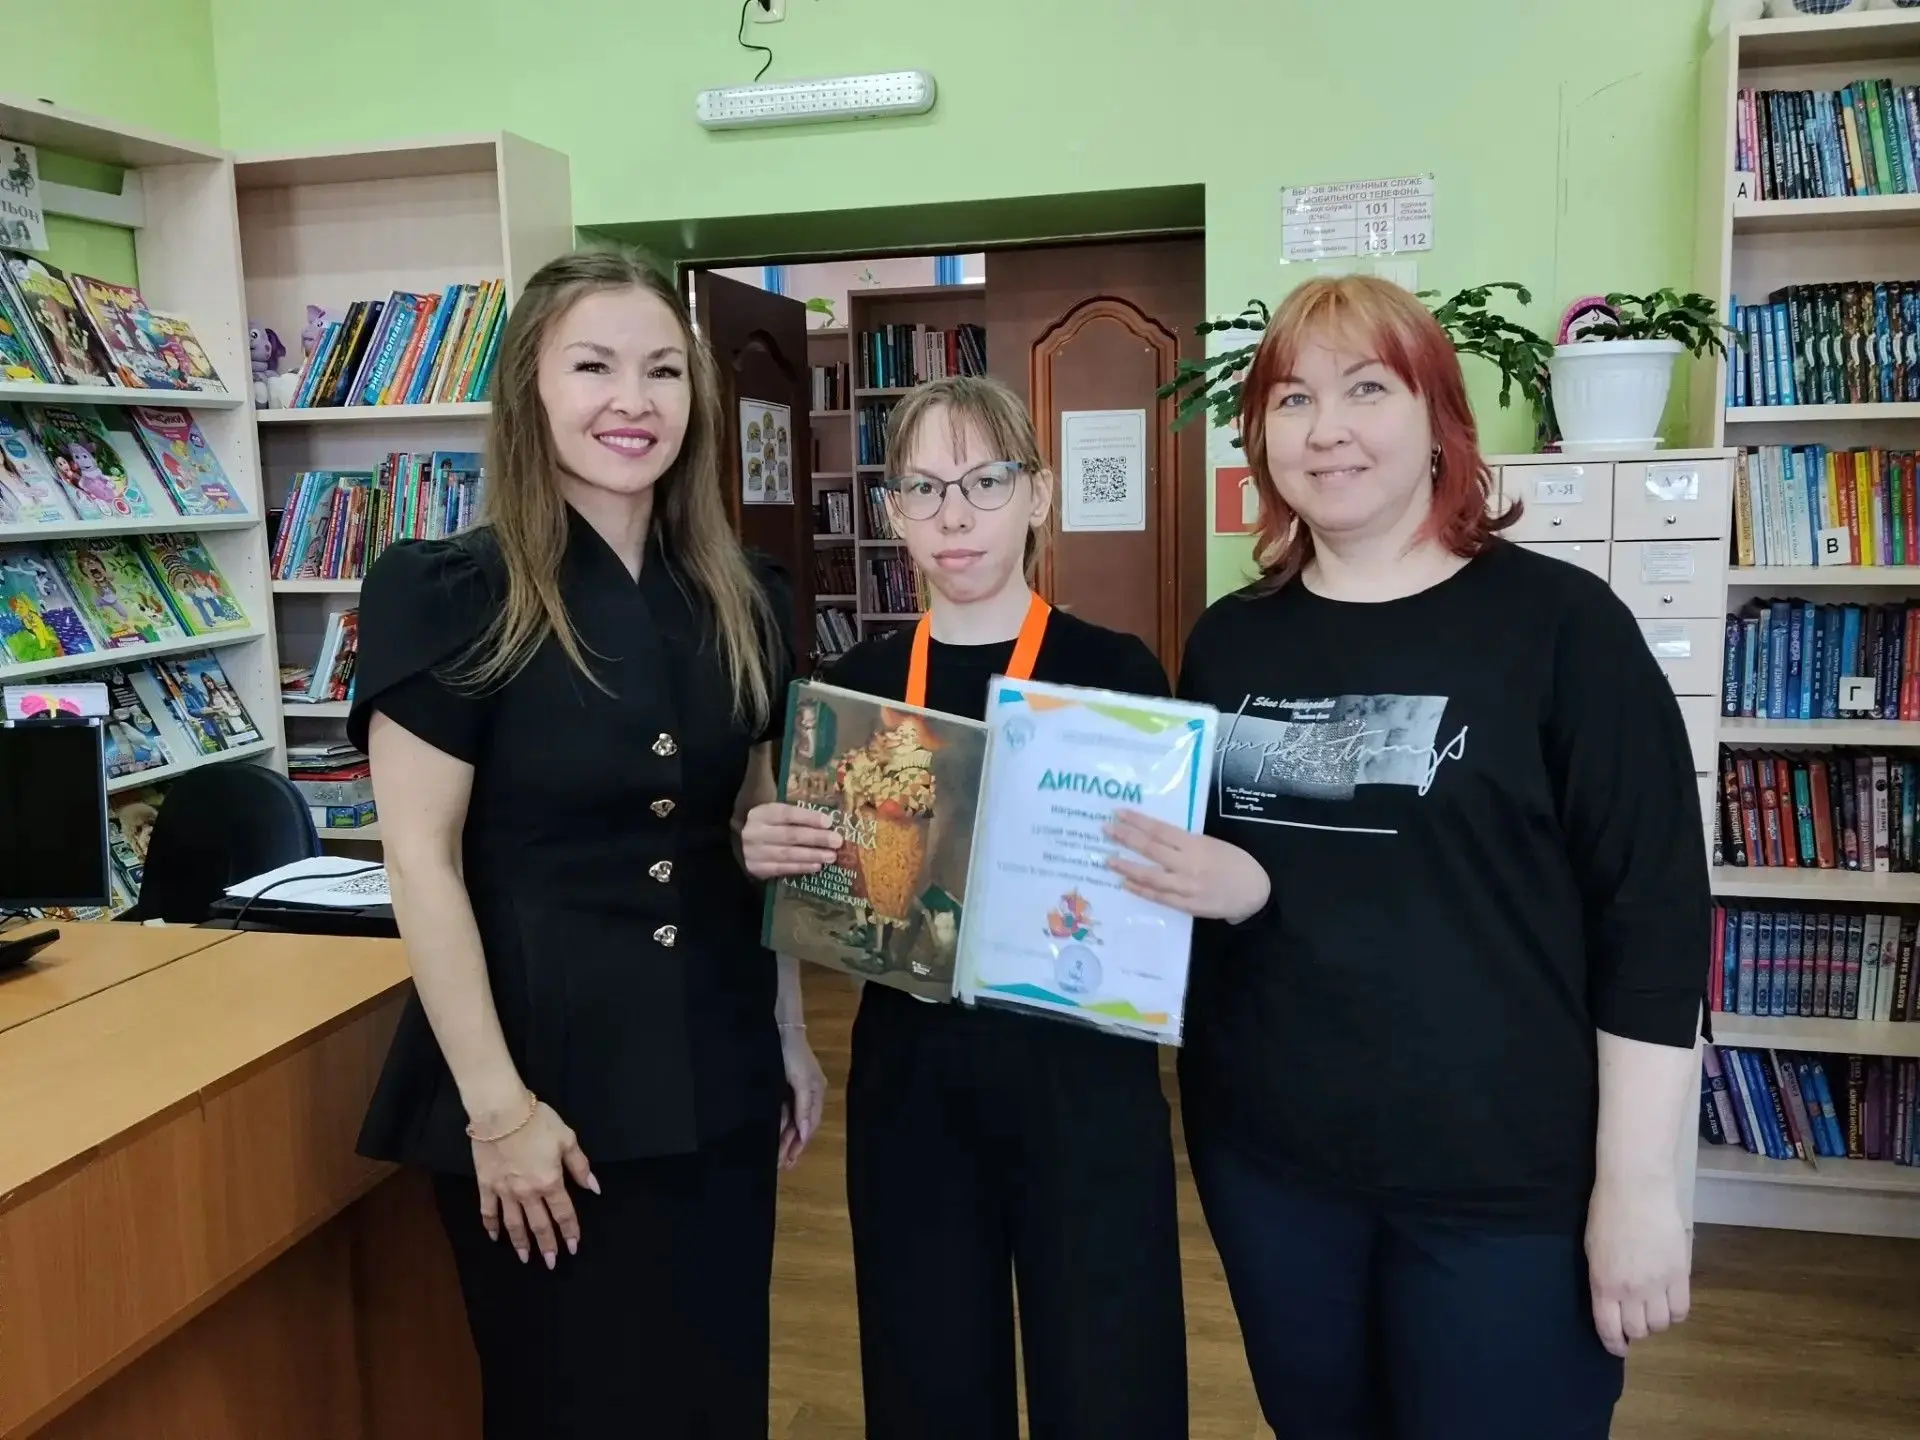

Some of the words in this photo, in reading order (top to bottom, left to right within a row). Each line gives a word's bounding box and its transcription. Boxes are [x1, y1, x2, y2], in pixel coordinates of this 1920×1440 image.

[1390, 178, 1423, 188] СЛУЖБ
[1737, 182, 1748, 198] А
[1370, 188, 1420, 199] ТЕЛЕФОНА
[1365, 203, 1388, 215] 101
[1365, 221, 1388, 233] 102
[1402, 233, 1426, 245] 112
[369, 312, 406, 391] ЭНЦИКЛОПЕДИЯ
[1826, 538, 1839, 554] В
[1850, 686, 1862, 701] Г
[1037, 768, 1143, 804] ДИПЛОМ
[823, 862, 858, 880] УШКИН
